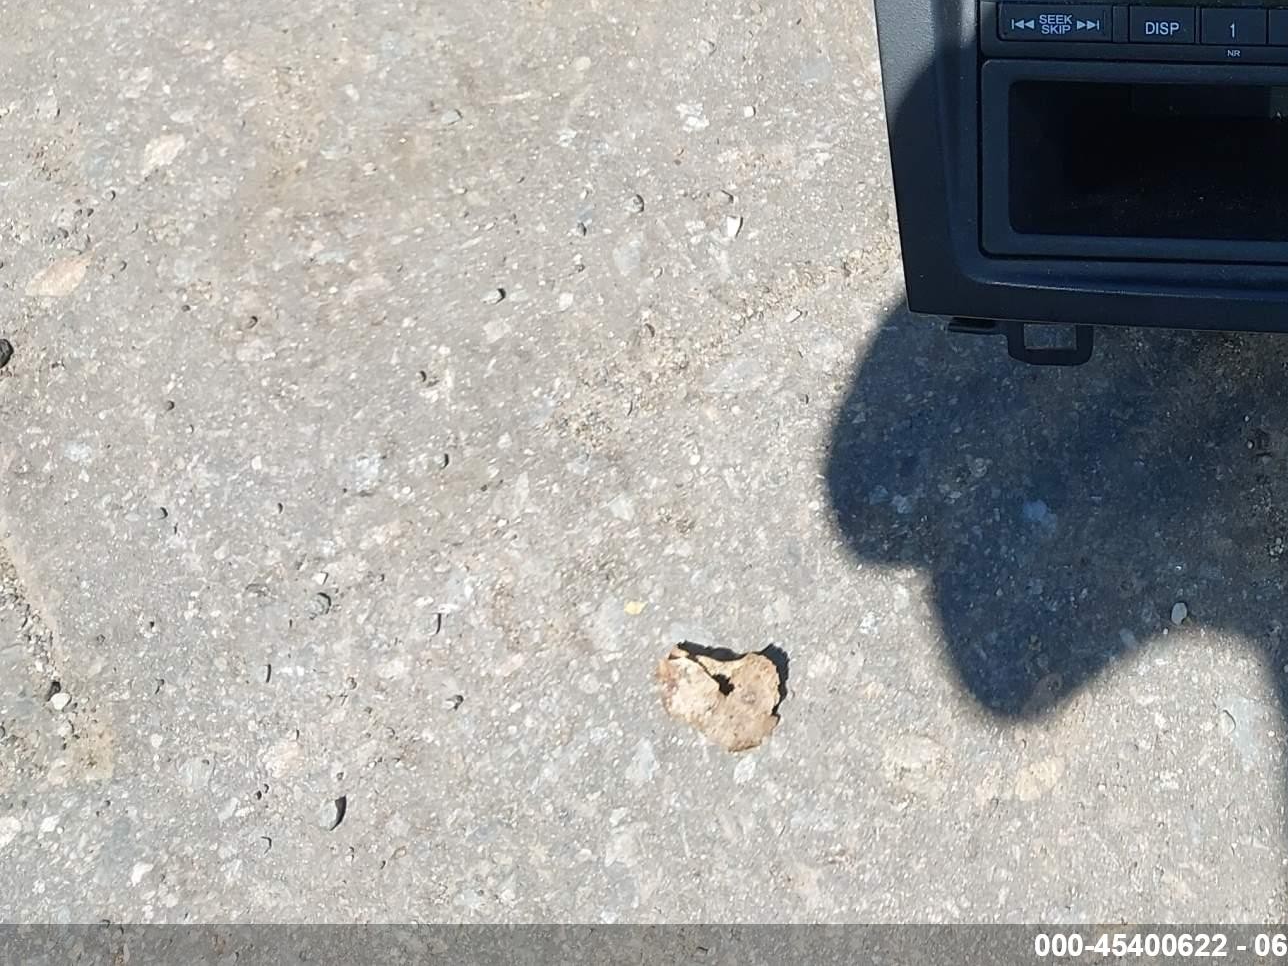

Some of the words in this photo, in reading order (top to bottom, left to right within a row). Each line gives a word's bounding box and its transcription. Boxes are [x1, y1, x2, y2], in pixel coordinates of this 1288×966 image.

[1039, 14, 1073, 25] SEEK
[1041, 24, 1072, 35] SKIP
[1145, 21, 1180, 35] DISP
[1229, 23, 1236, 39] 1
[1227, 49, 1241, 58] NR
